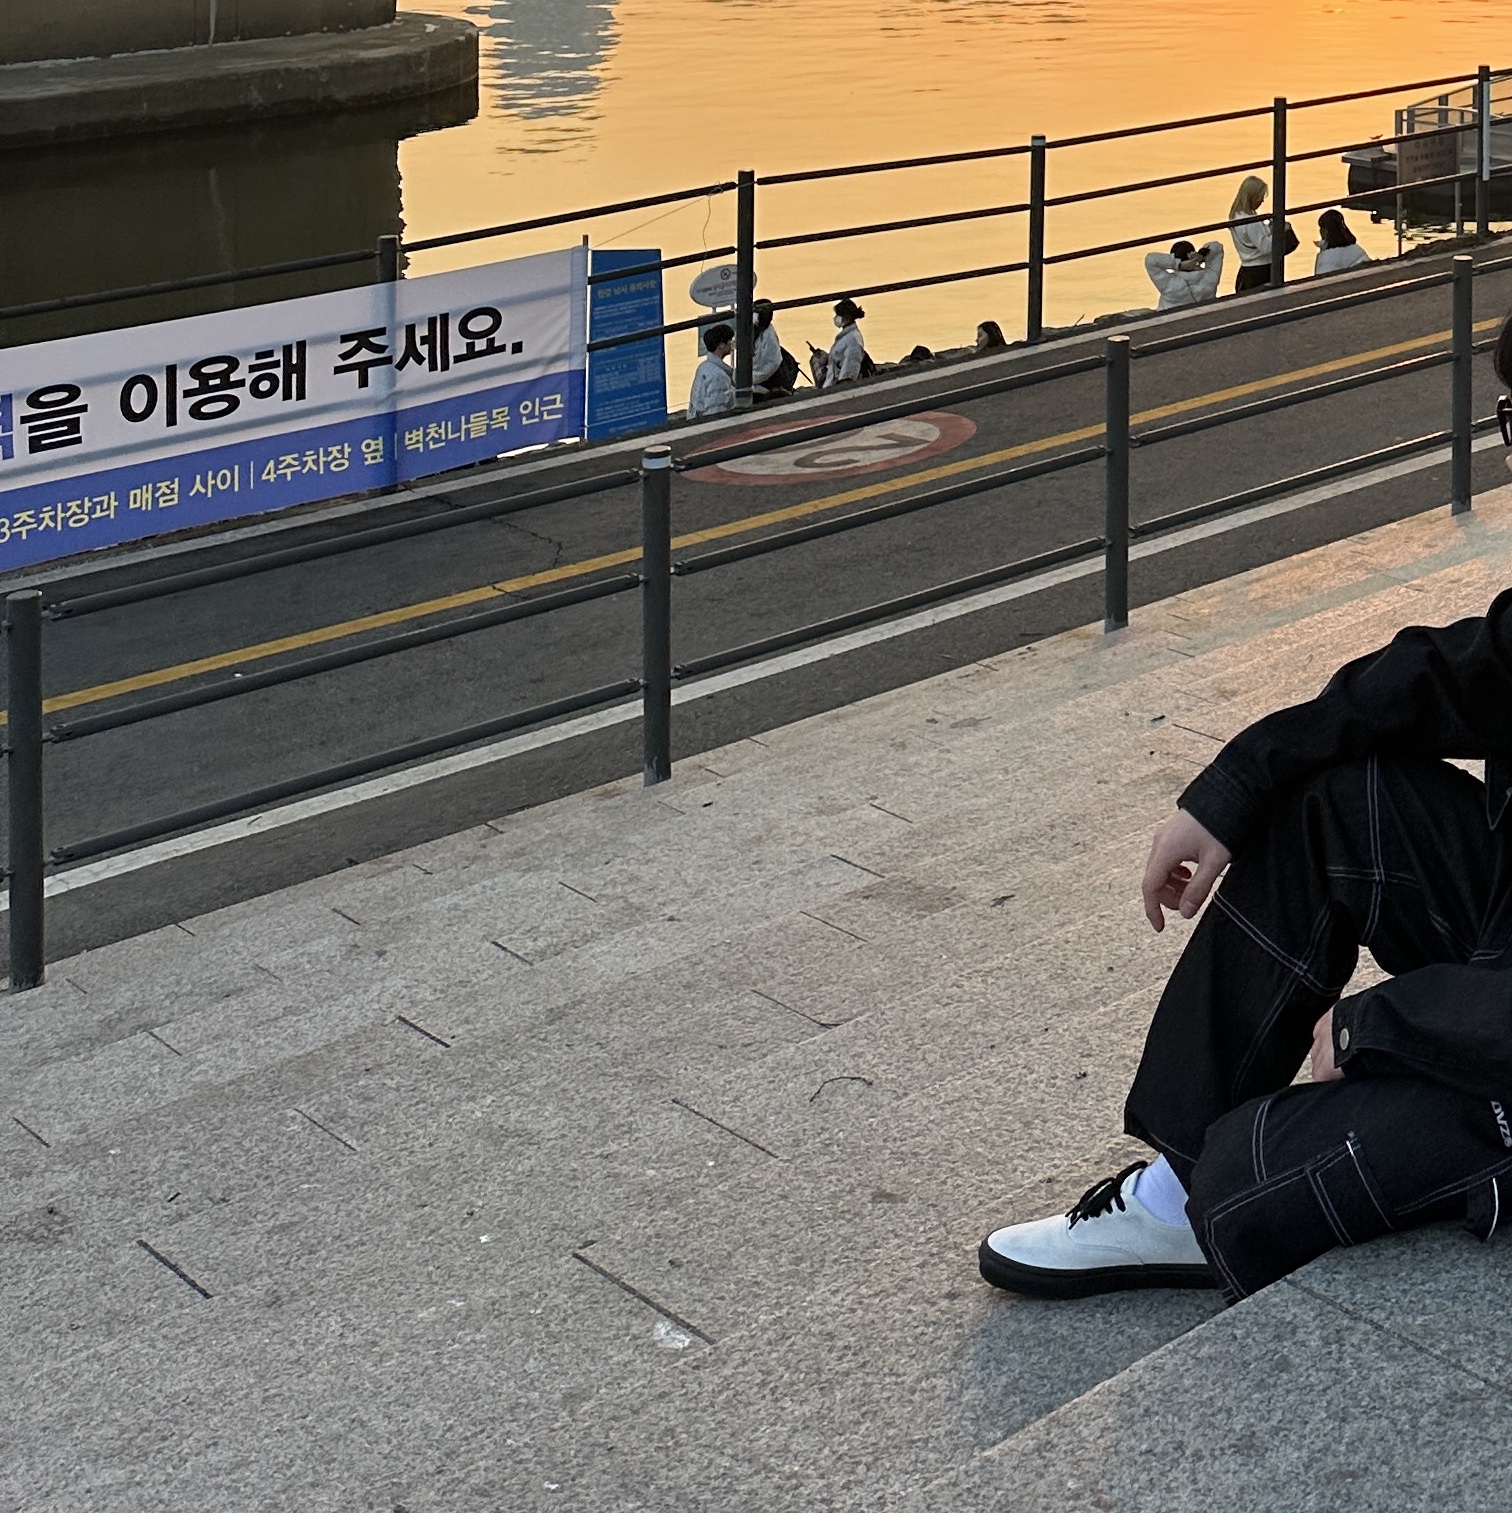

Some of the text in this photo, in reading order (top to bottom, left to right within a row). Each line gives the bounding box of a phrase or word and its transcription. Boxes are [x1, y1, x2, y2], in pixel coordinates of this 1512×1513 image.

[119, 340, 308, 428] 이용해
[333, 306, 524, 389] 주세요.
[0, 393, 565, 544] 3주차장과 매점 사이 4주차장 옆 벽천나들목 인근
